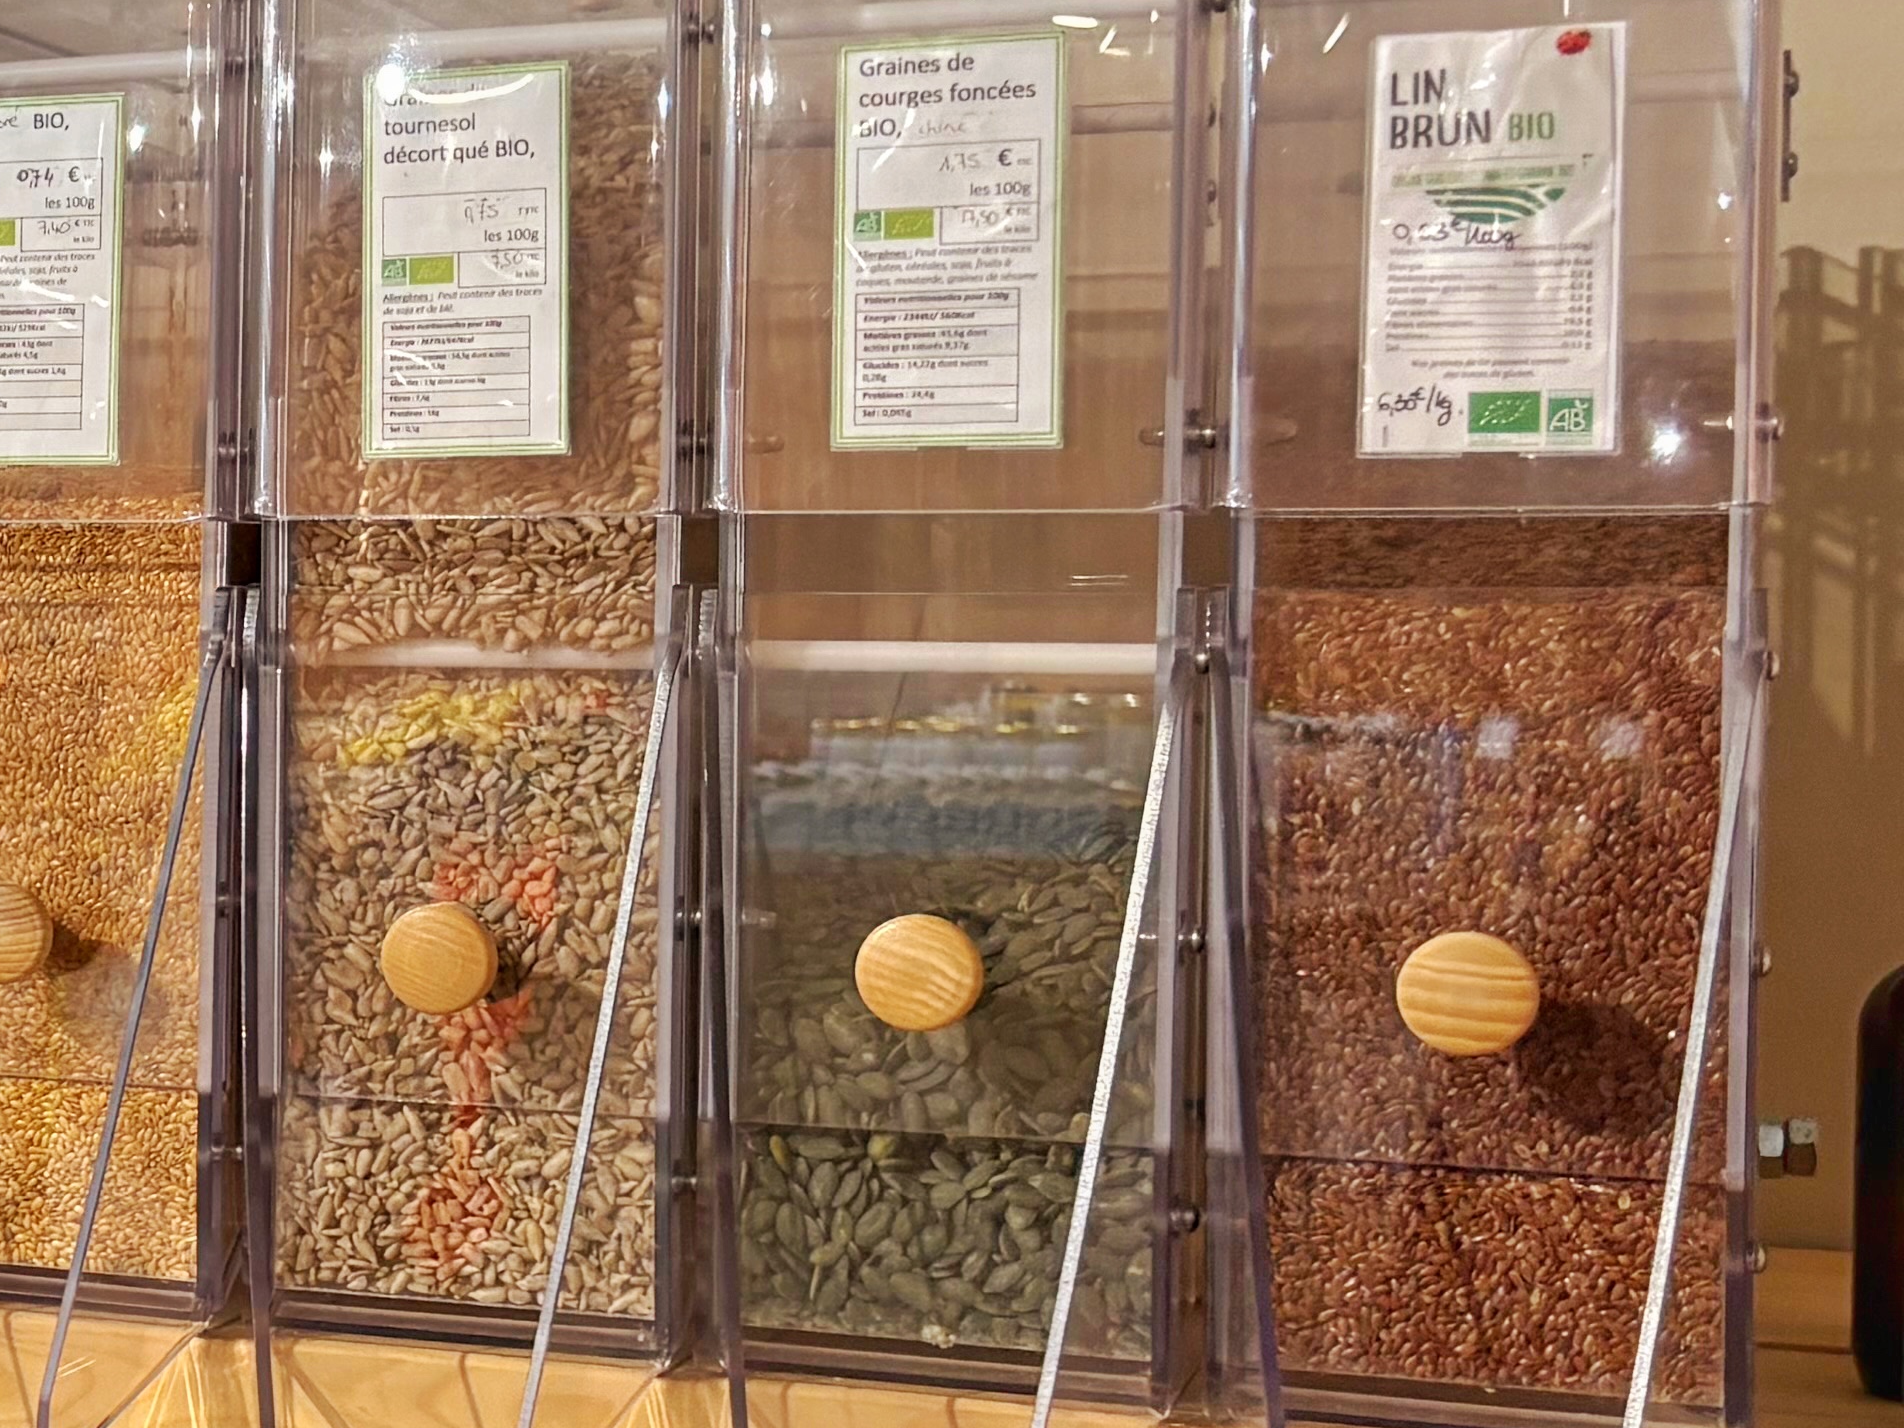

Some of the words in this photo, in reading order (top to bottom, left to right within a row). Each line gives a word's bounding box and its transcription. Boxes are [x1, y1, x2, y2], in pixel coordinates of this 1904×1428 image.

[860, 57, 940, 77] Graines
[948, 53, 974, 72] de
[859, 89, 942, 108] courges
[950, 80, 1036, 102] foncées
[1392, 69, 1446, 106] LIN
[34, 112, 70, 131] BIO,
[385, 113, 475, 135] tournesol
[1390, 109, 1491, 150] BRUN
[1509, 112, 1554, 142] BIO
[496, 139, 535, 159] BIO,
[69, 166, 80, 182] €
[970, 183, 990, 197] les
[996, 182, 1031, 197] 100g
[45, 197, 61, 209] les
[66, 197, 94, 210] 100g
[484, 229, 502, 242] les
[507, 228, 539, 242] 100g
